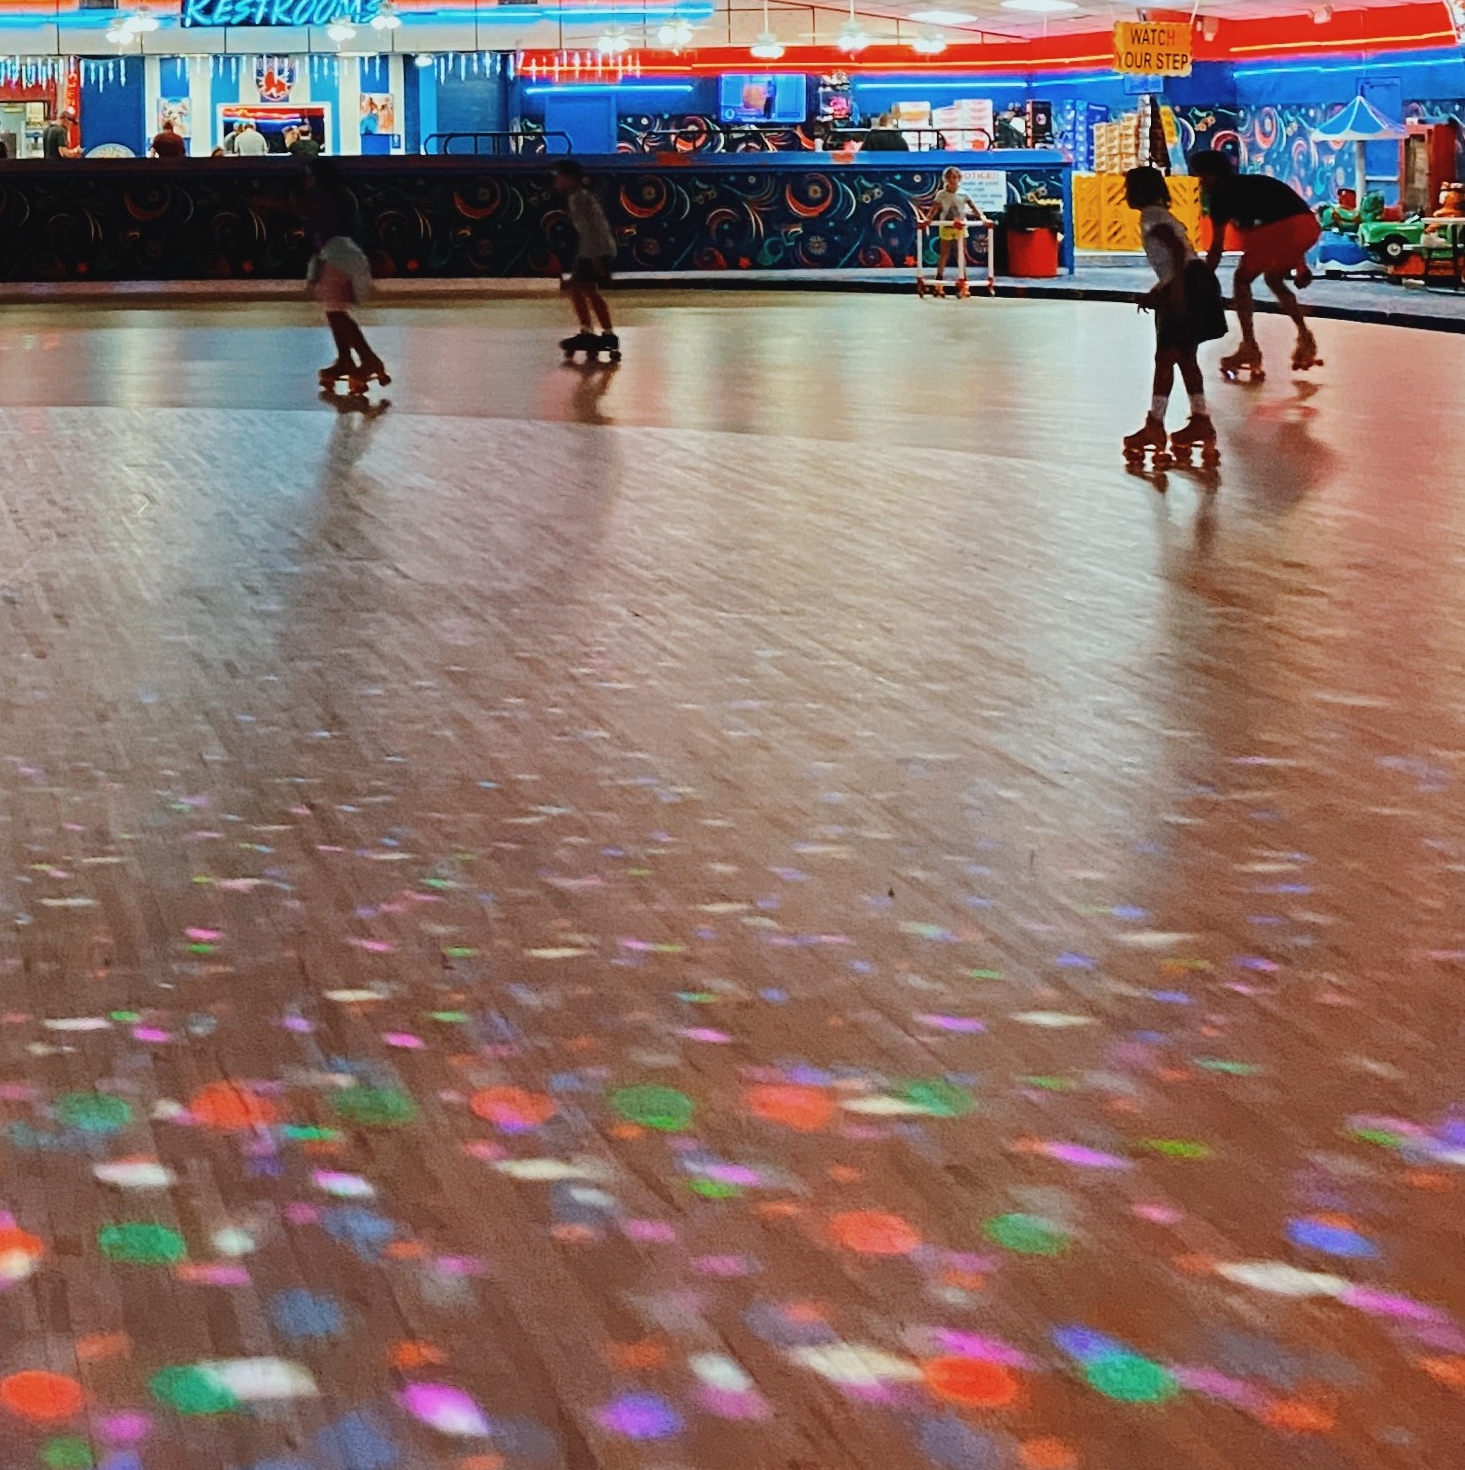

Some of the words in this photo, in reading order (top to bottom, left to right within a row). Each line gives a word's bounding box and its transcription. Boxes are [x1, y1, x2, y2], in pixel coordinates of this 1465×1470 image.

[1130, 29, 1176, 46] WATCH
[1116, 51, 1152, 70] YOUR
[1156, 52, 1189, 71] STEP
